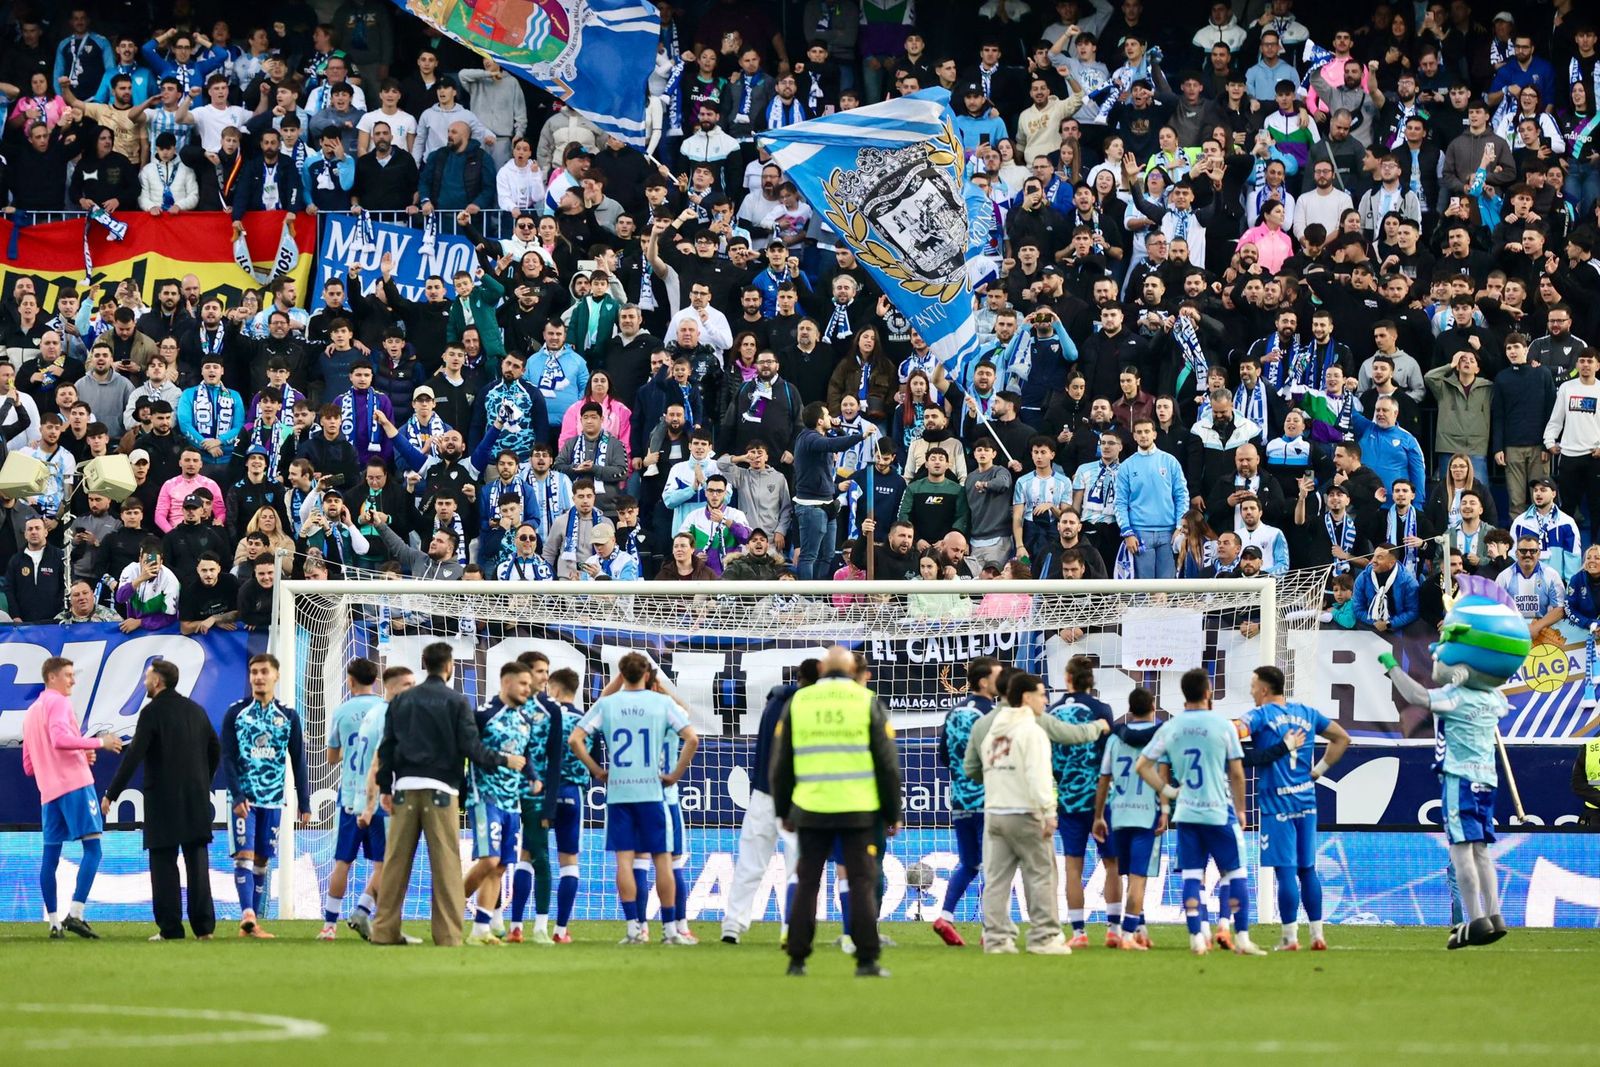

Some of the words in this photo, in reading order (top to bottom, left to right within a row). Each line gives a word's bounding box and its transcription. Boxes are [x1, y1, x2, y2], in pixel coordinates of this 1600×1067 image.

[967, 201, 995, 248] MONT
[325, 220, 412, 277] MUY
[871, 631, 898, 662] EL
[906, 629, 1021, 663] CALLEJO
[1508, 655, 1581, 684] ALAGA
[620, 704, 646, 718] NIÑO
[889, 696, 937, 708] MÁLAGA
[612, 727, 651, 768] 21
[1183, 747, 1204, 790] 3
[235, 817, 247, 836] 9
